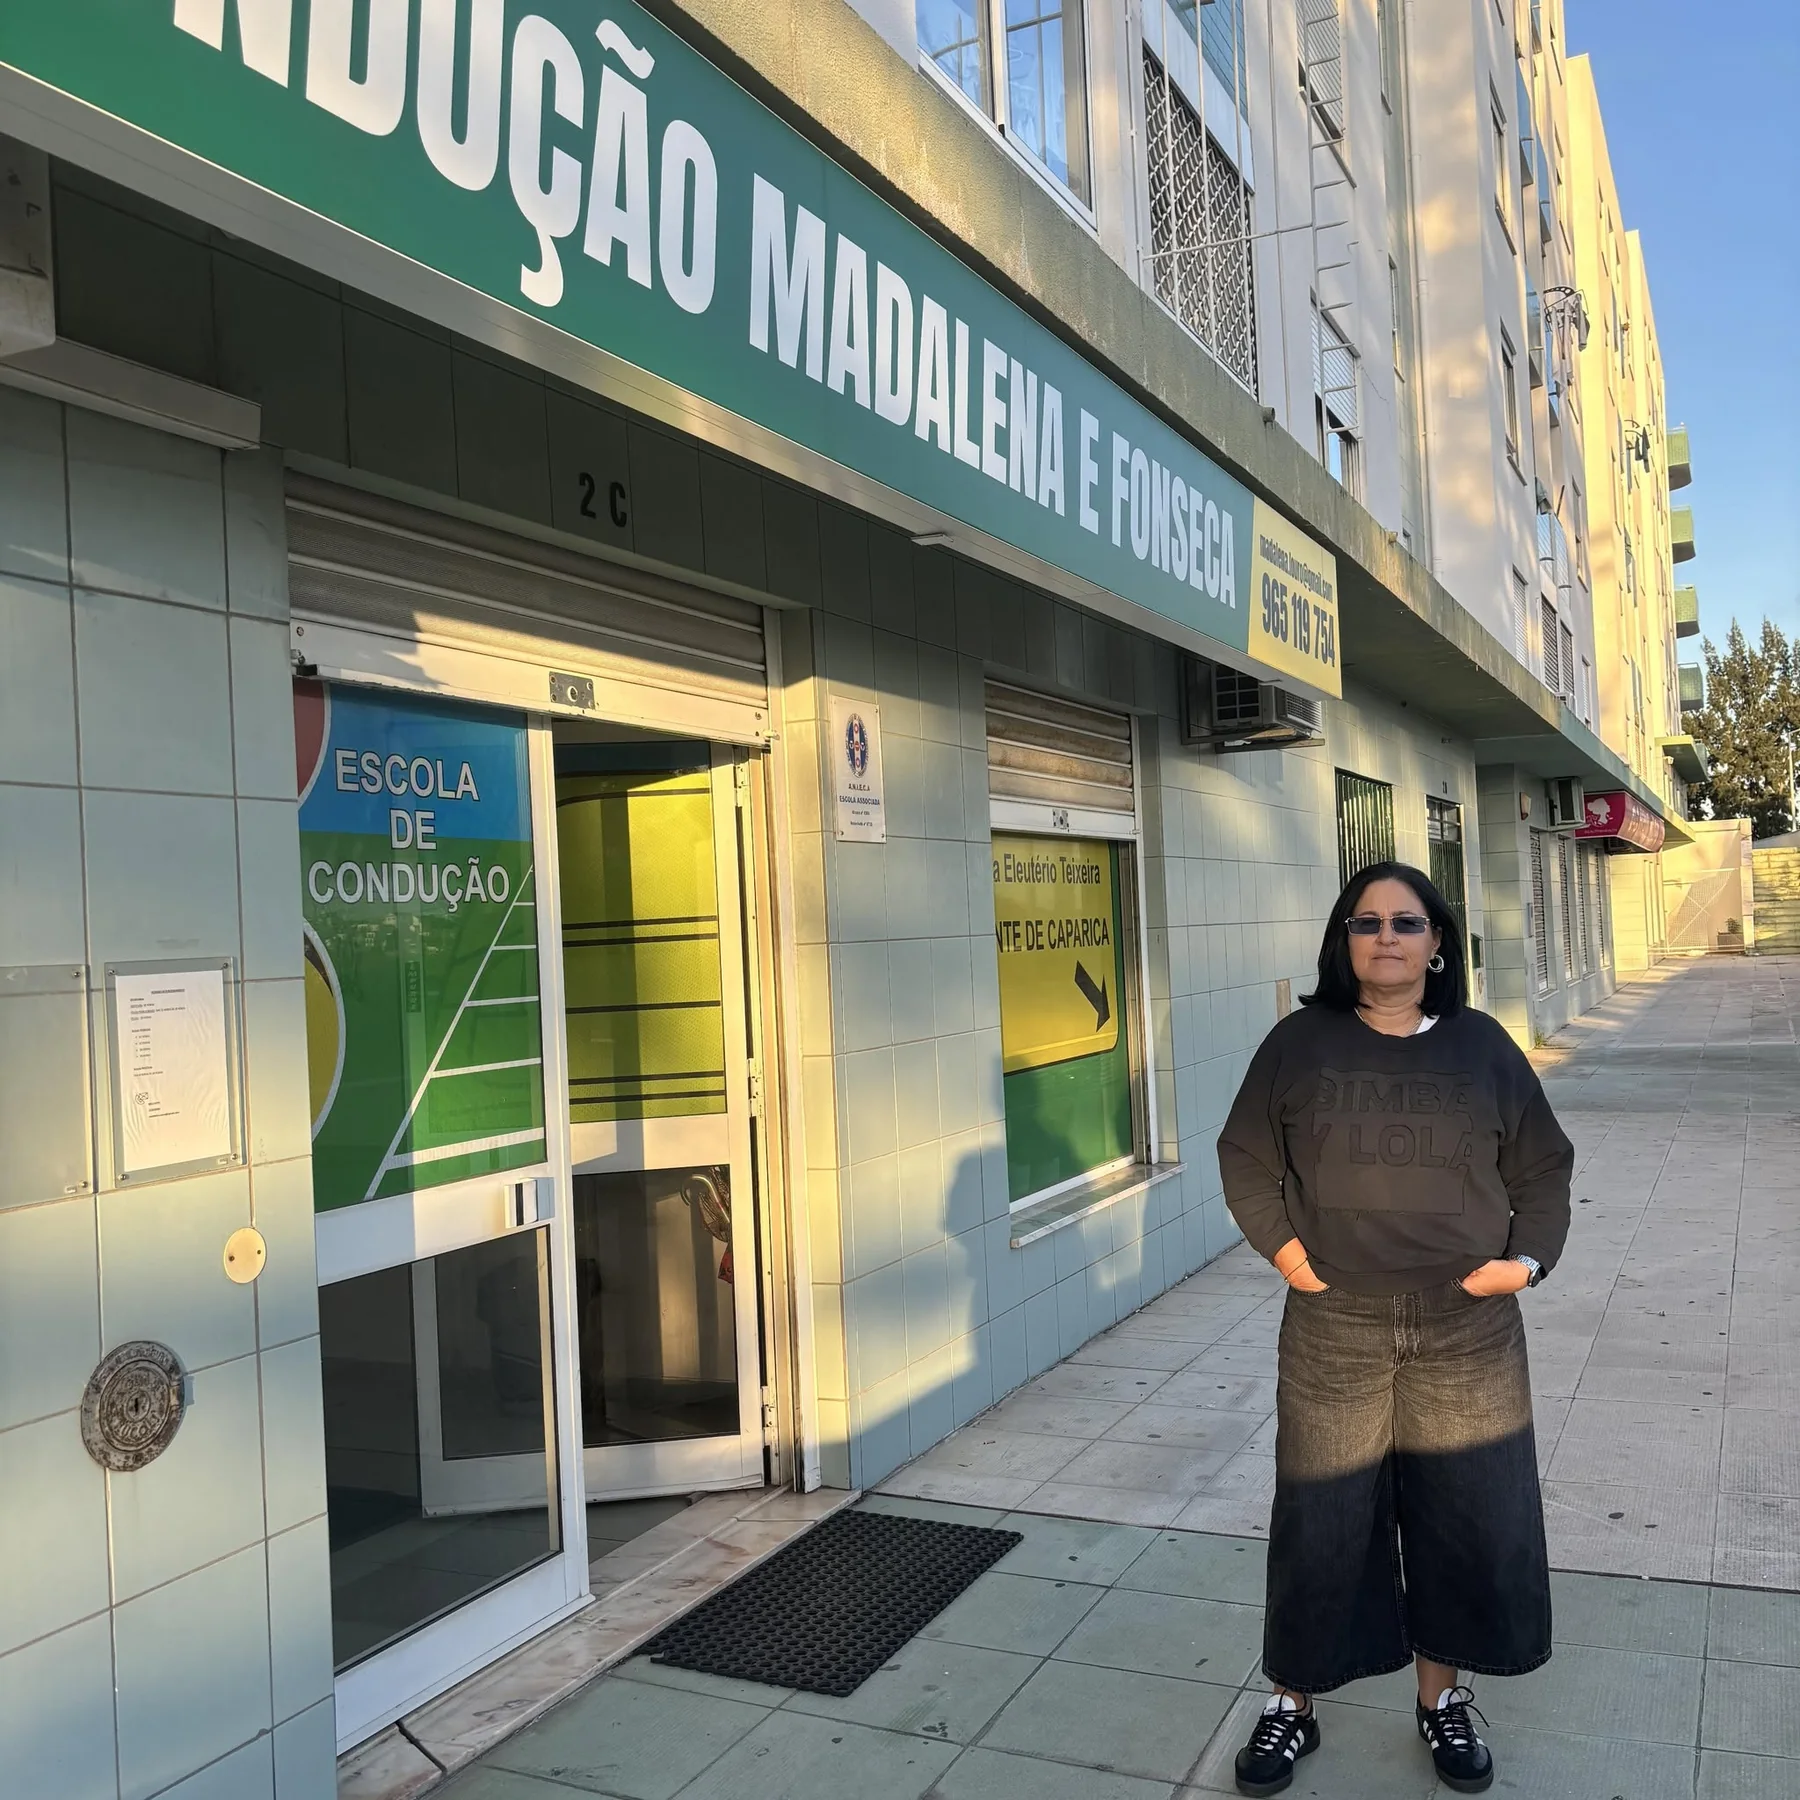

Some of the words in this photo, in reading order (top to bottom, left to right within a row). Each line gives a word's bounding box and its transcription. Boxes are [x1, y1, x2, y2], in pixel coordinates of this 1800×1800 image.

[173, 0, 719, 314] DUÇÃO
[749, 173, 1065, 517] MADALENA
[1078, 407, 1099, 535] E
[1111, 430, 1236, 609] FONSECA
[579, 472, 597, 520] 2
[609, 481, 628, 528] C
[1261, 572, 1289, 644] 965
[1291, 591, 1311, 655] 119
[1313, 604, 1335, 668] 754
[335, 748, 480, 802] ESCOLA
[389, 807, 437, 850] DE
[307, 856, 510, 913] CONDUÇÃO
[1004, 853, 1057, 884] Eleutério
[1059, 856, 1101, 885] Teixeira
[1026, 919, 1044, 951] DE
[1048, 917, 1110, 950] CAPARICA
[1349, 1124, 1473, 1169] LOLA
